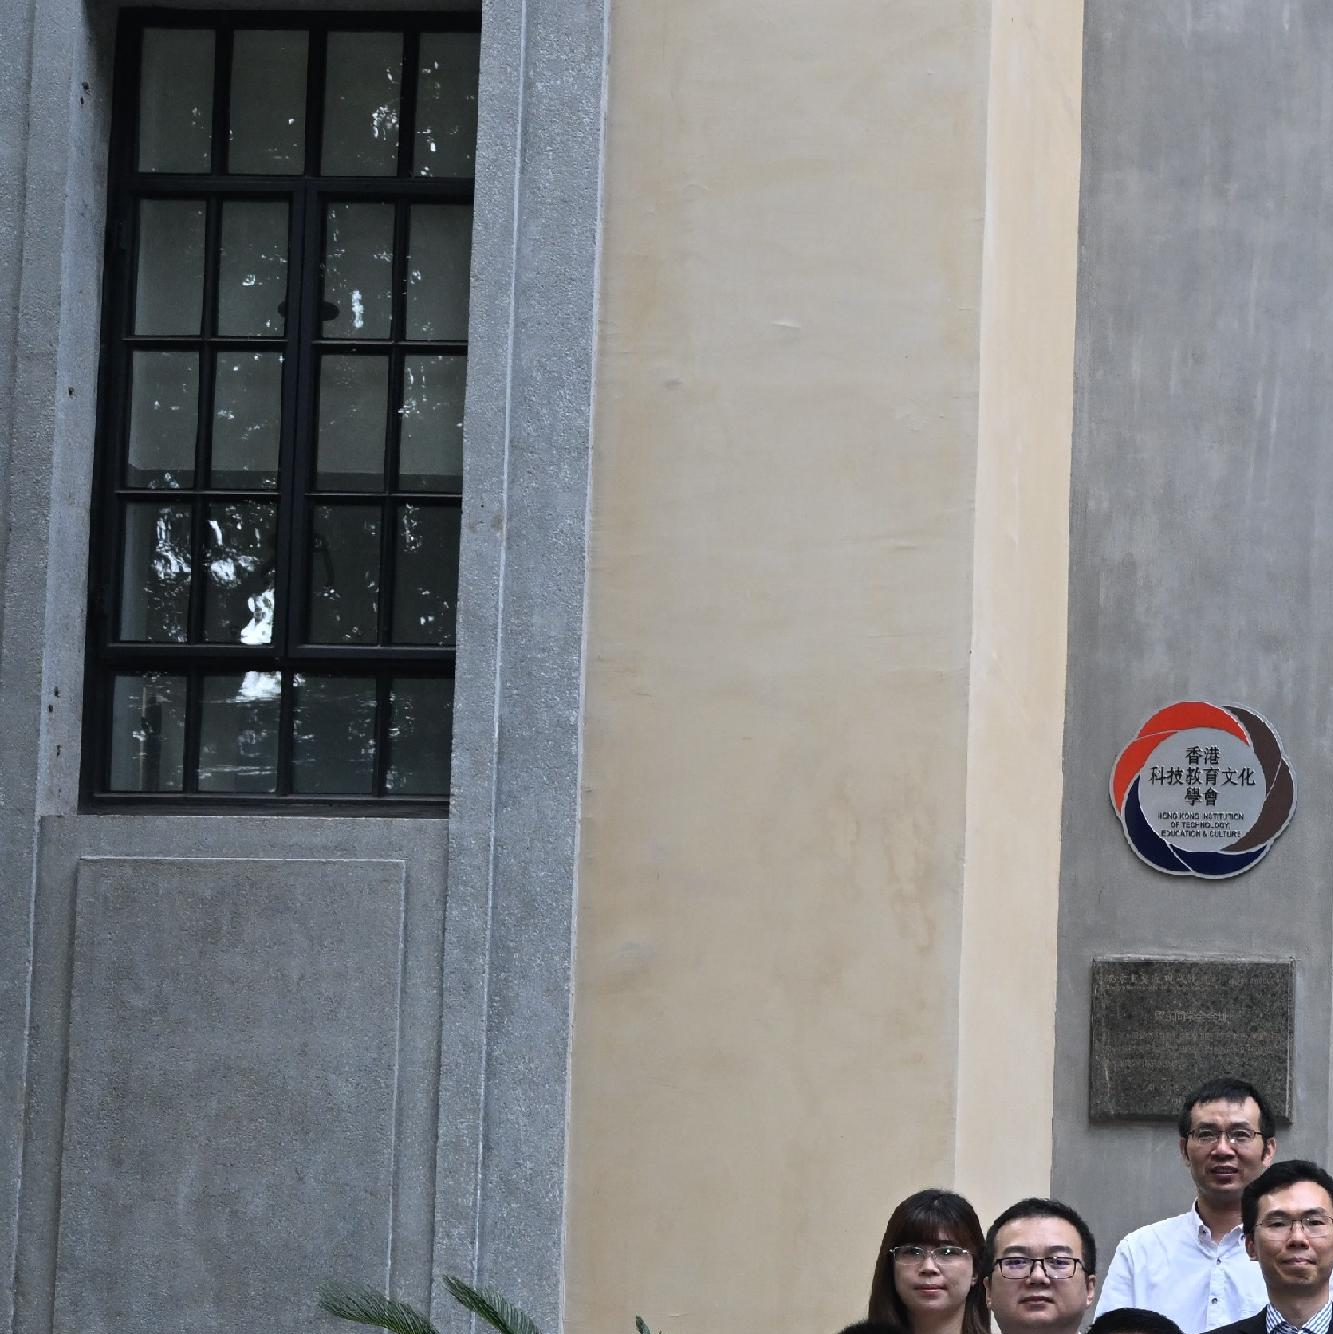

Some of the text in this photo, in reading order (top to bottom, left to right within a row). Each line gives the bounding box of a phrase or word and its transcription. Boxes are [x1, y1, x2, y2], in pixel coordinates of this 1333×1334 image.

[1184, 745, 1220, 766] 香港
[1149, 766, 1256, 786] 科技教育文化
[1184, 787, 1219, 807] 學會
[1170, 821, 1180, 829] OF
